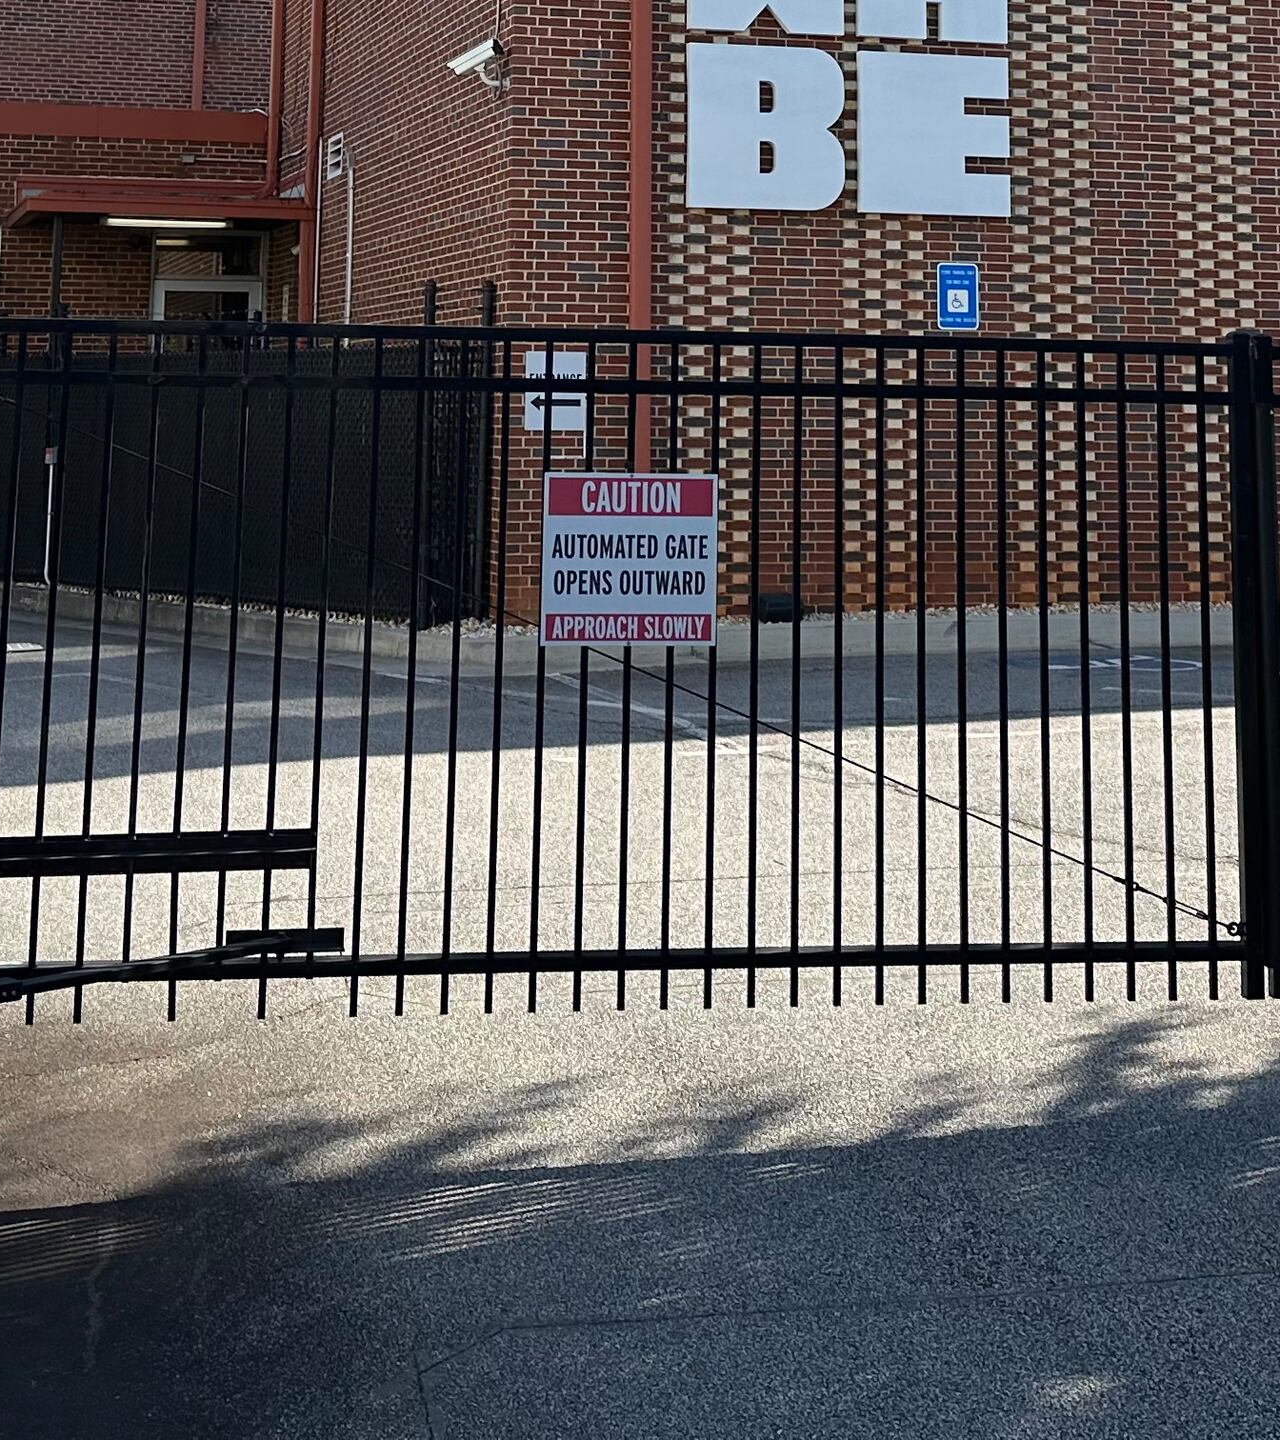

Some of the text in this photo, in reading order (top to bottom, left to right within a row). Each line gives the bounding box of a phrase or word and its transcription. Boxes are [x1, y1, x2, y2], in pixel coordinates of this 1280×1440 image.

[686, 42, 1011, 217] BE
[581, 480, 681, 513] CAUTION
[552, 533, 709, 559] AUTOMATED GATE
[553, 569, 706, 595] OPENS OUTWARD
[552, 615, 705, 640] APPROACH SLOWLY
